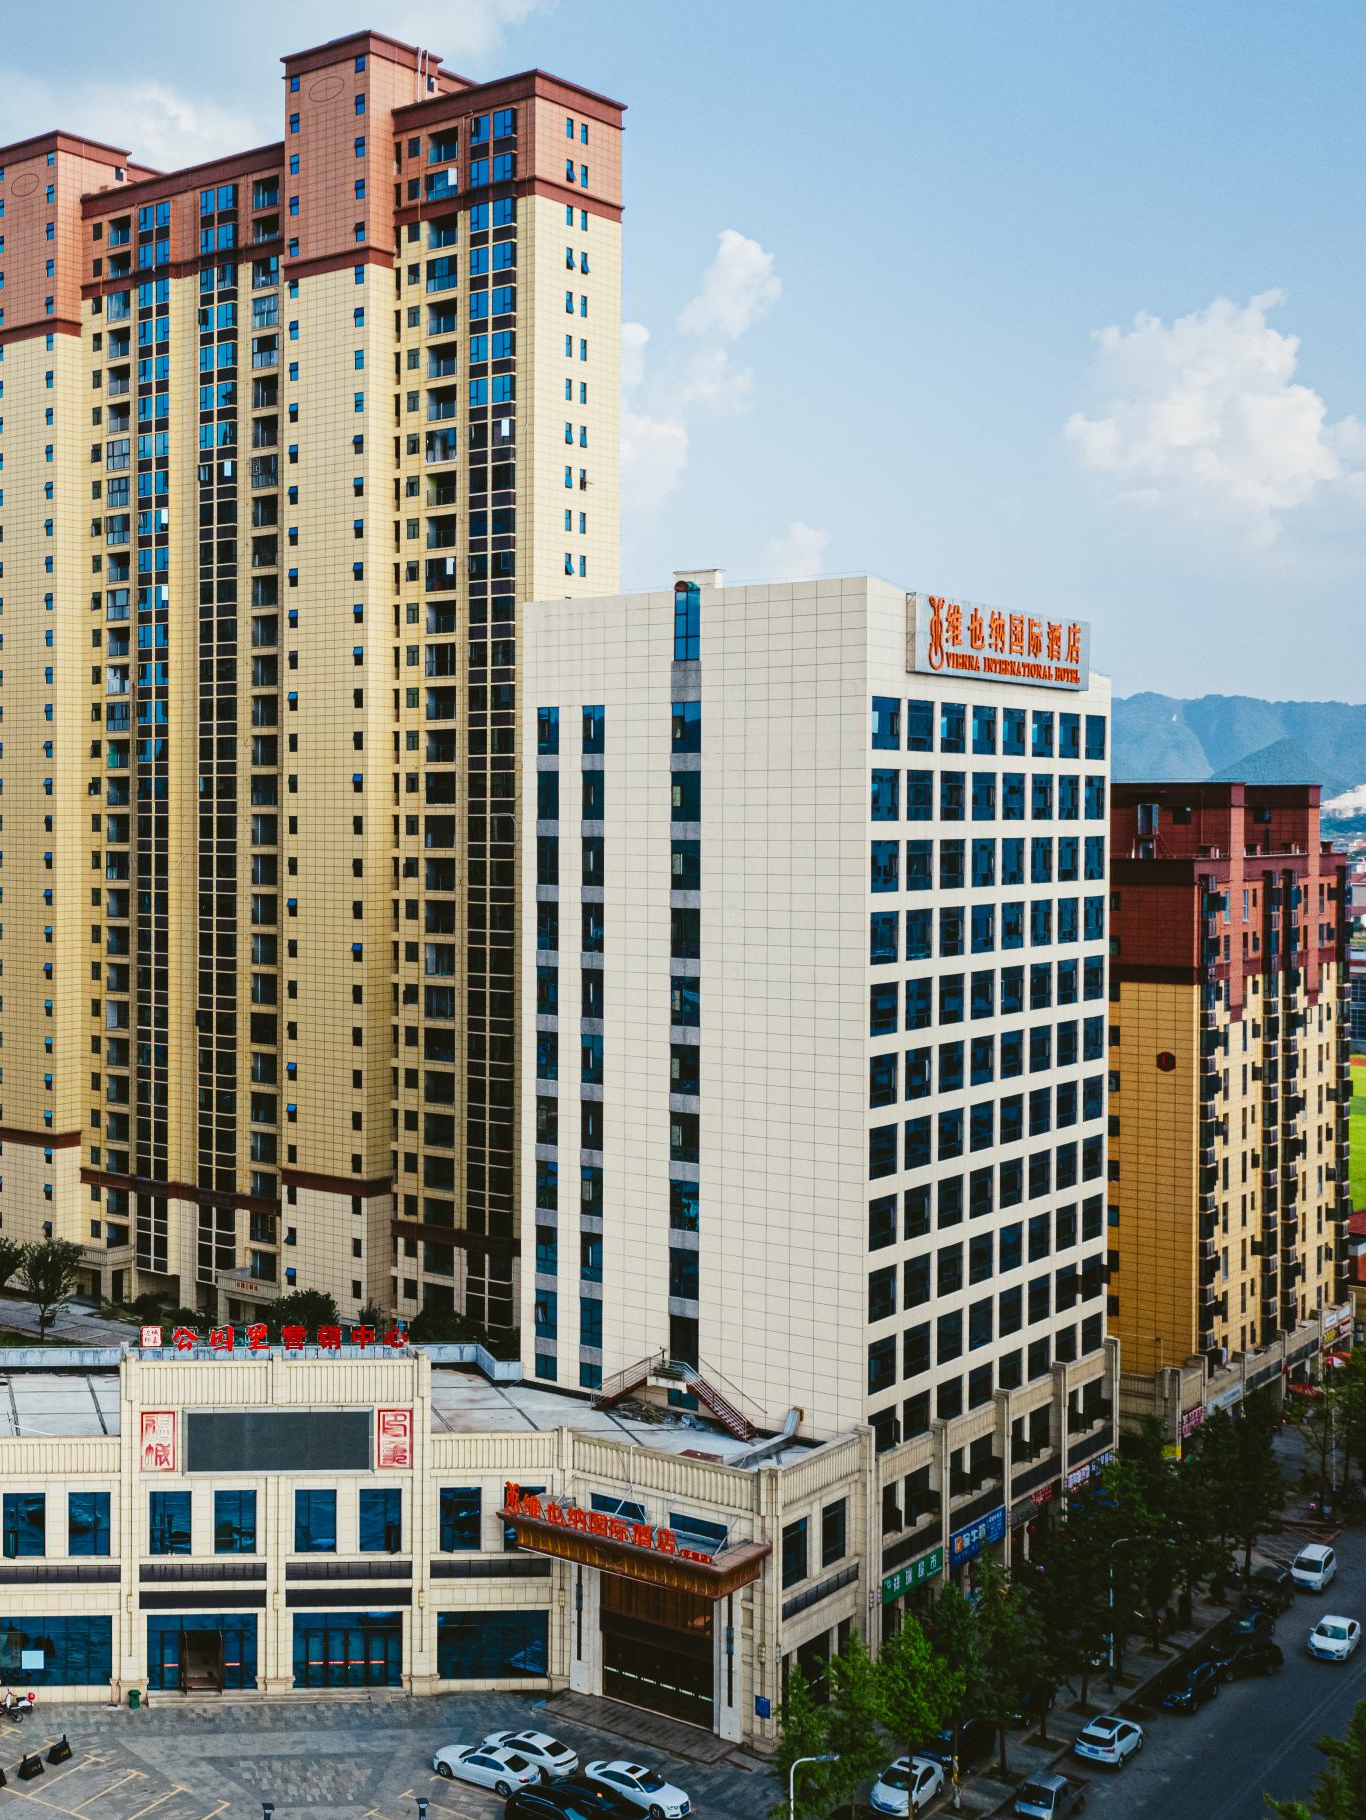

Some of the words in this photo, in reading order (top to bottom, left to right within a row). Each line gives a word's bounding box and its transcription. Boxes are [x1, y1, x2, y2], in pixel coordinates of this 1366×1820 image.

[945, 603, 1082, 664] 维也纳国际酒店
[946, 652, 981, 671] VIENNA
[983, 657, 1053, 680] INTERNATIONAL
[1055, 667, 1080, 683] HOTEL
[172, 1323, 409, 1352] 公园里营销中心
[522, 1493, 677, 1555] 维也纳国际酒店
